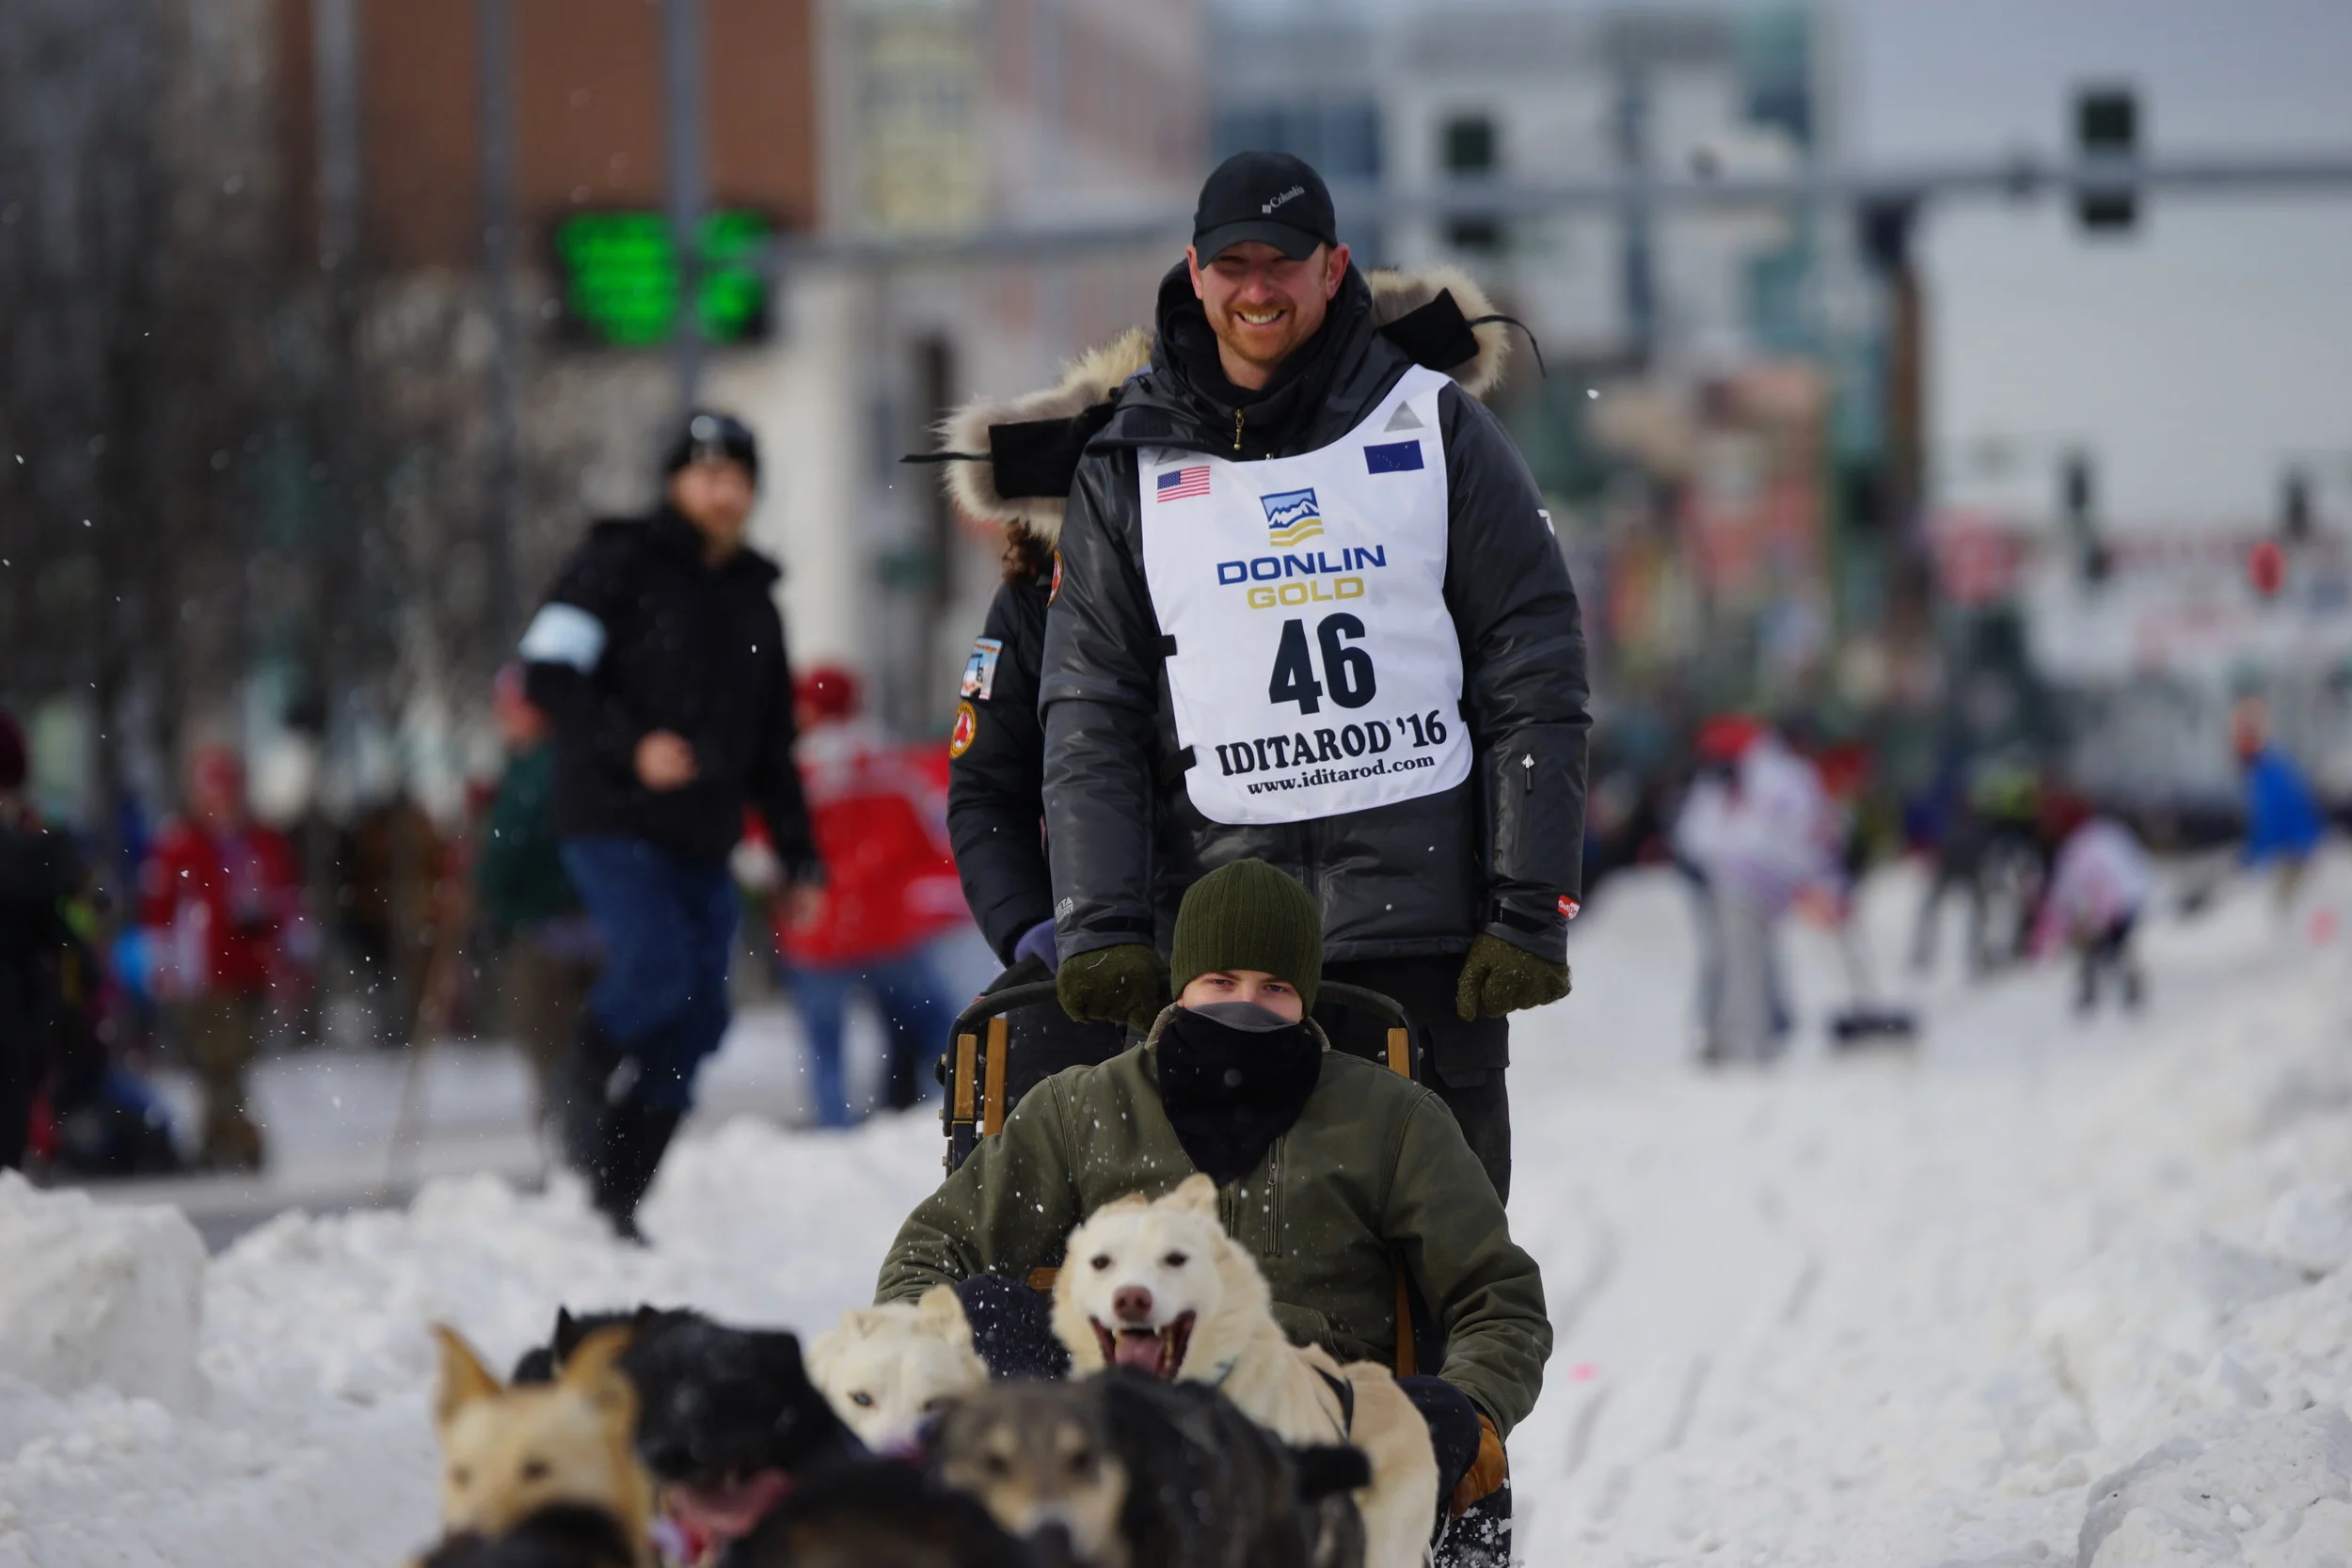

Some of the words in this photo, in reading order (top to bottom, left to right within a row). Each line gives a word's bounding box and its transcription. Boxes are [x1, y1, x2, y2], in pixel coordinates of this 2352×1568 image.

[1216, 545, 1387, 586] DONLIN
[1247, 577, 1364, 610] GOLD
[1268, 612, 1376, 716] 46
[1396, 709, 1447, 748] '16
[1247, 755, 1436, 795] www.iditarod.com
